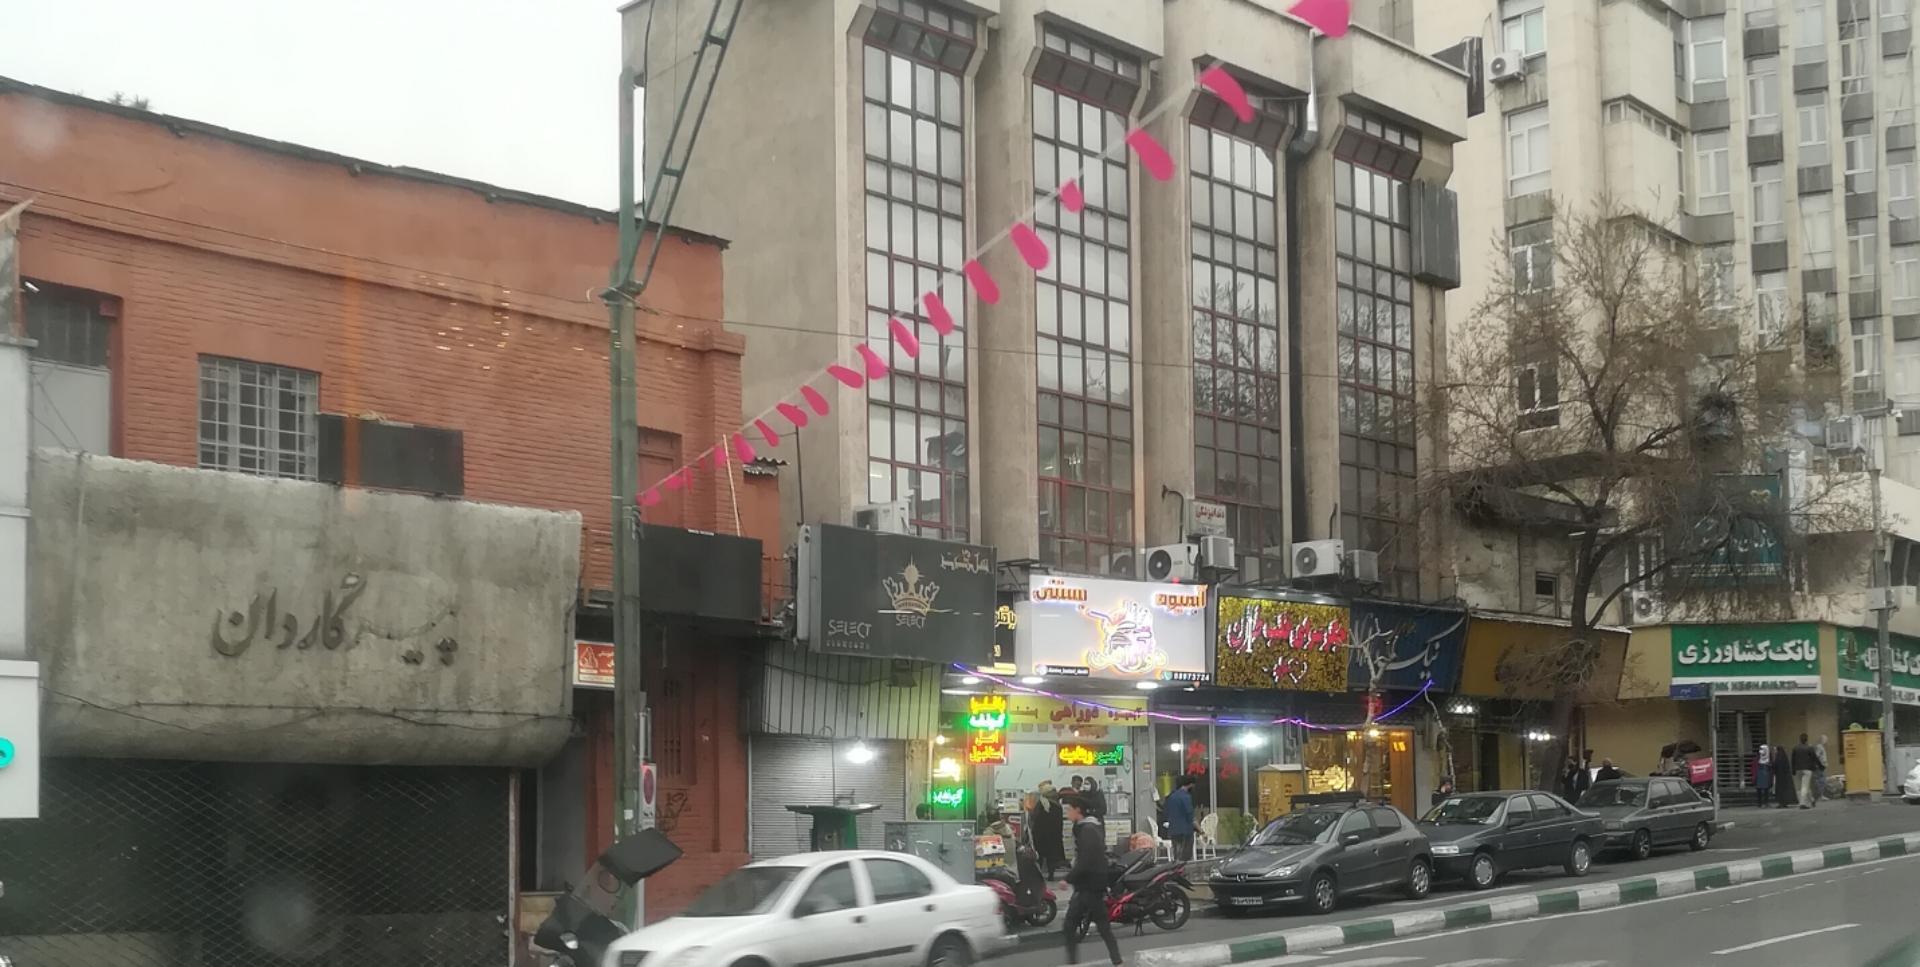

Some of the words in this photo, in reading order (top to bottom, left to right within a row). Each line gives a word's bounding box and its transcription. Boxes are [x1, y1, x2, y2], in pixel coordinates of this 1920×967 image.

[1033, 579, 1088, 609] بستنی
[1156, 585, 1209, 615] آبمیوه
[827, 618, 873, 640] SELECT
[896, 612, 928, 631] SELECT
[1678, 639, 1771, 665] کشاورزی
[1769, 639, 1818, 669] بانک
[1050, 702, 1099, 722] دوراهی
